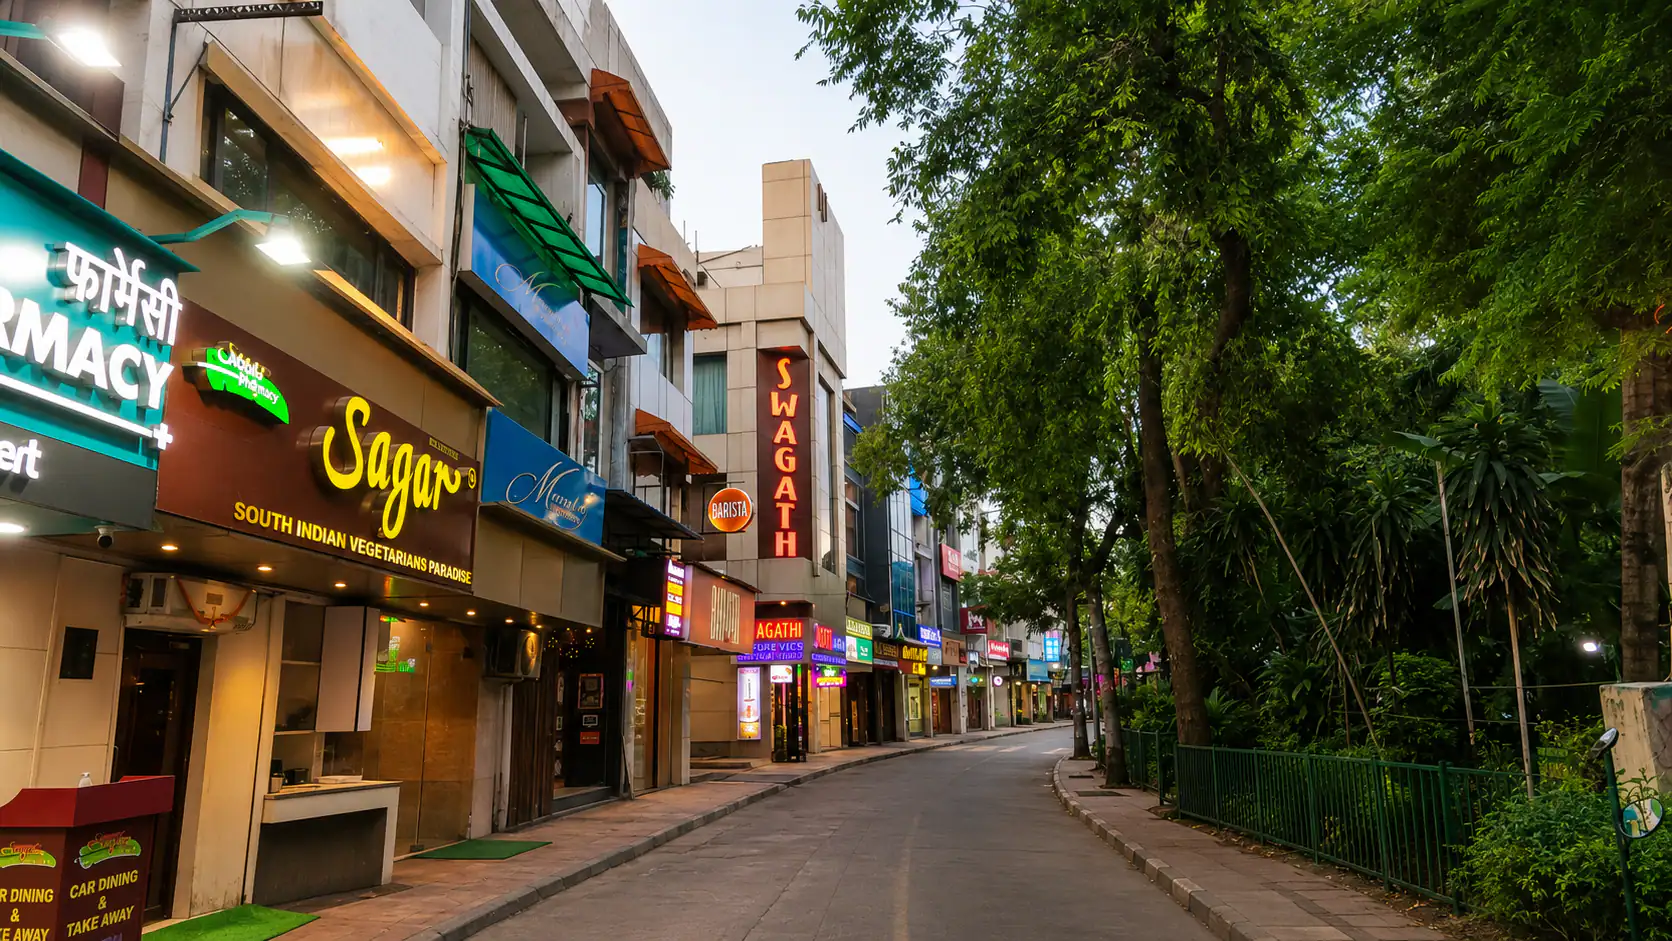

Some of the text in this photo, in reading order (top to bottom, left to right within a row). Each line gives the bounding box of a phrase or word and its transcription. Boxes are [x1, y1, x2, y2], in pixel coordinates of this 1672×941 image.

[323, 397, 461, 539] Sagar
[770, 357, 799, 557] SWAGATH
[712, 500, 748, 519] BARISTA
[233, 501, 472, 585] SOUTH INDIAN VEGETARIANS PARADISE
[10, 888, 54, 903] DINING
[69, 869, 139, 899] CAR DINING
[10, 908, 20, 923] &
[97, 895, 107, 910] &
[66, 905, 136, 938] TAKE AWAY
